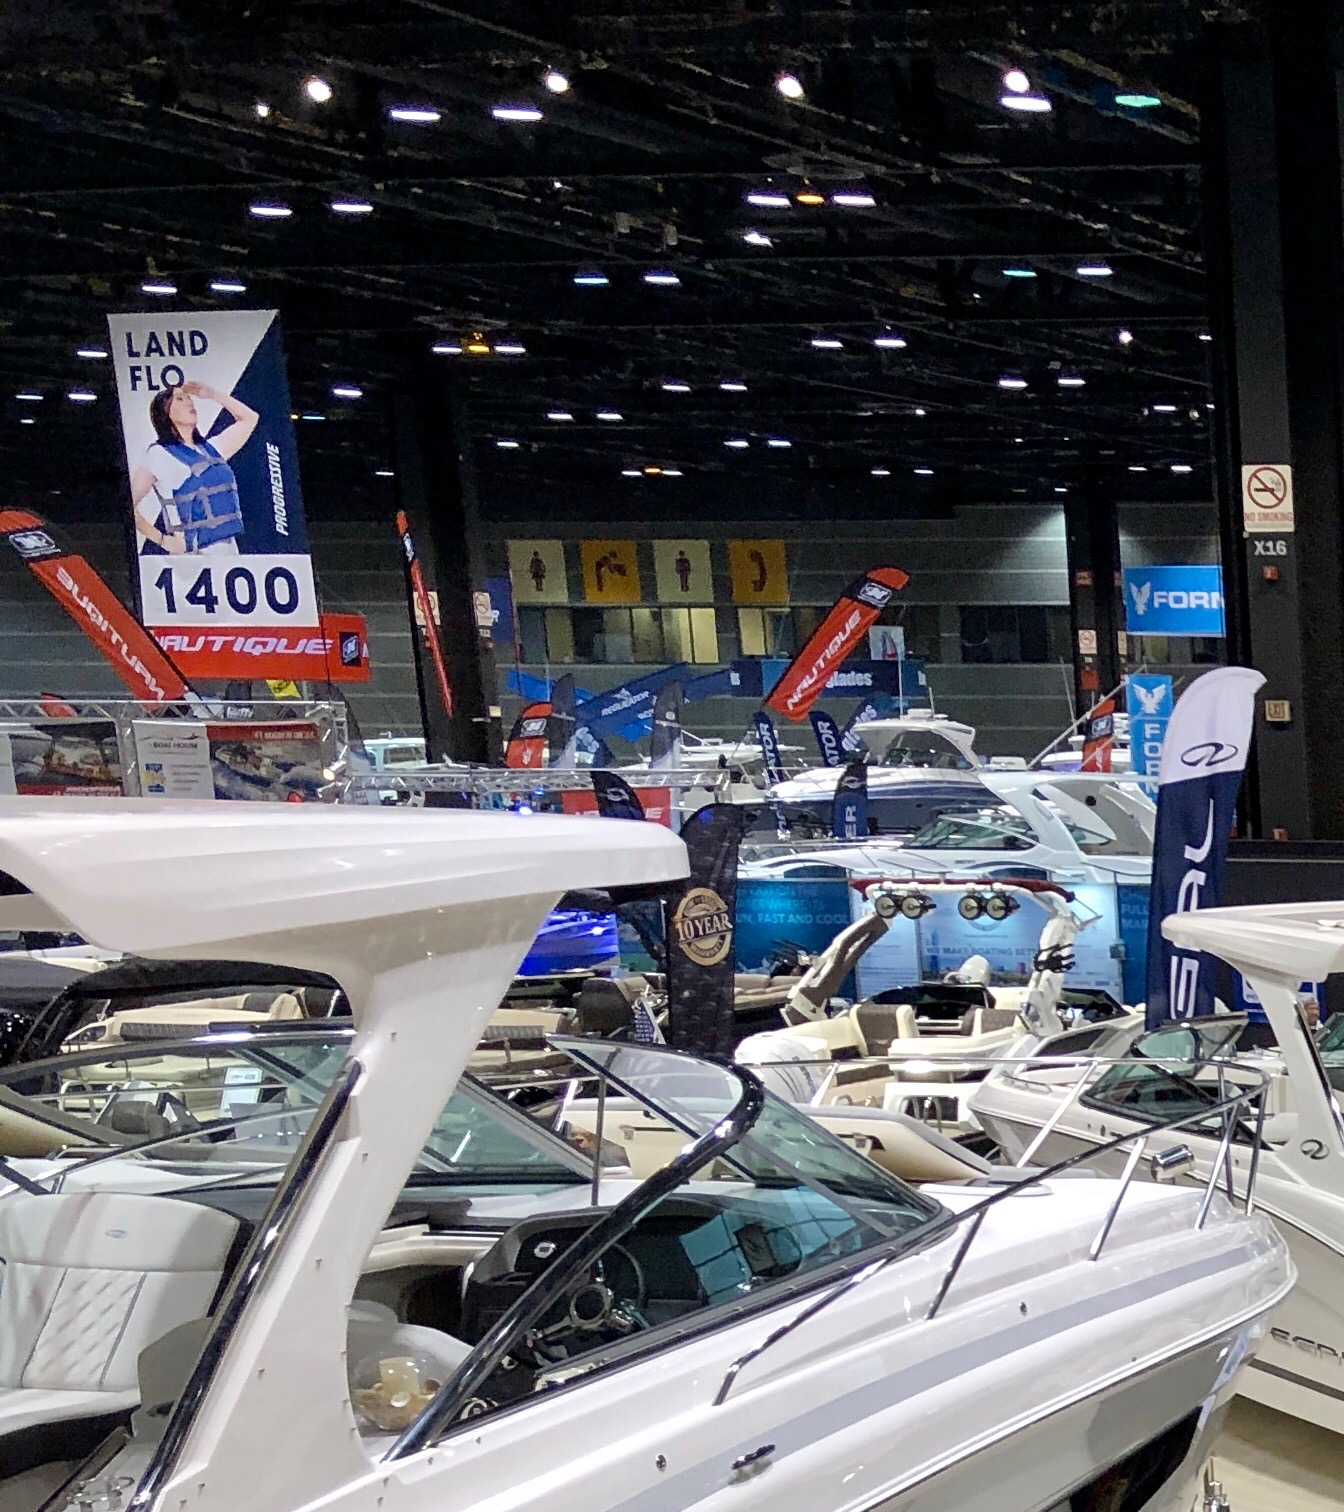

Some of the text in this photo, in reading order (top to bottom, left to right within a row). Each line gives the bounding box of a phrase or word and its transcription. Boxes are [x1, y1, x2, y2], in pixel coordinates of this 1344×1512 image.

[125, 330, 208, 358] LAND
[130, 364, 185, 391] FLO
[265, 441, 289, 536] PROGRESSIVE
[1244, 511, 1293, 523] NO SMOKING
[1254, 540, 1287, 556] X16
[155, 567, 300, 615] 1400
[786, 608, 863, 711] NAUTIQUE
[675, 912, 734, 941] 10 YEAR
[758, 913, 785, 923] FAST
[787, 914, 813, 924] AND
